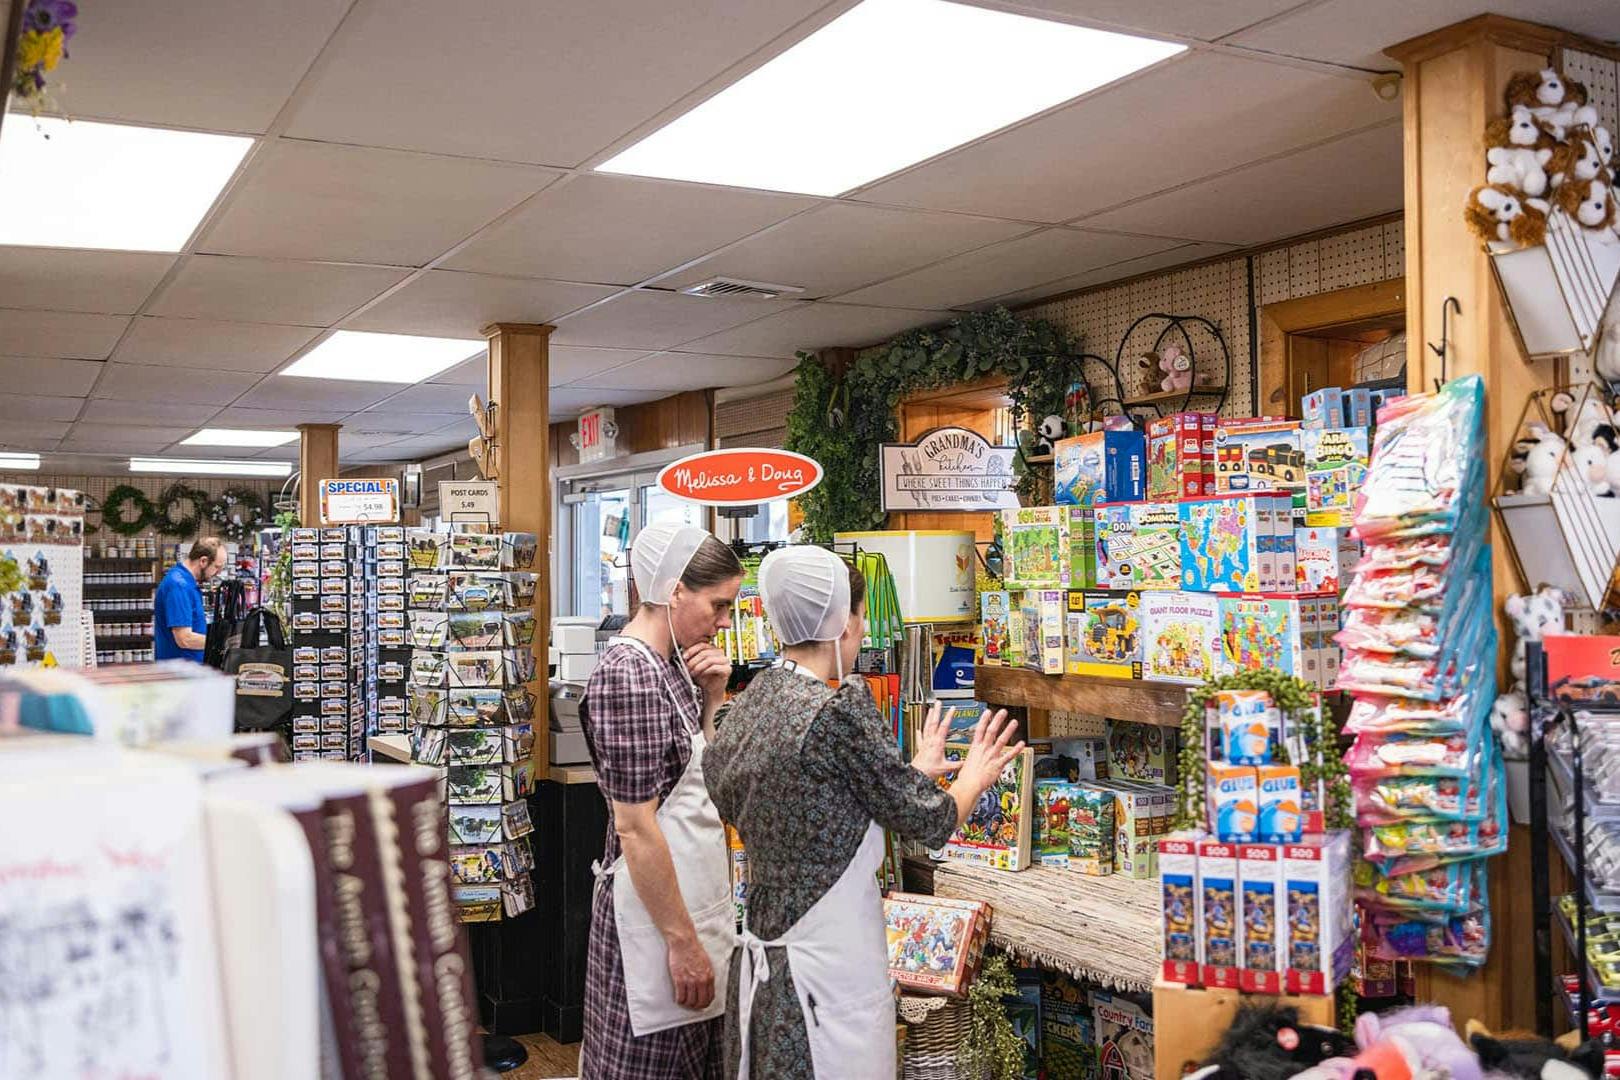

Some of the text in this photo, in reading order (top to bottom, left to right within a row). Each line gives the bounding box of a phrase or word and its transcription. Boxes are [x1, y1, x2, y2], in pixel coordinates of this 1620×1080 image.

[580, 413, 600, 449] EXIT
[1320, 431, 1348, 446] FARM
[923, 433, 985, 459] GRANDMA'S
[1315, 443, 1356, 457] BINGO
[674, 463, 803, 494] Melissa & Doug
[903, 479, 925, 489] WHERE
[929, 479, 952, 489] SWEET
[955, 479, 979, 489] THINGS
[328, 481, 391, 493] SPECIAL !
[450, 489, 489, 497] POST CARDS
[1149, 606, 1214, 618] GIANT FLOOR PUZZLE
[1231, 700, 1266, 716] GLUE
[1220, 775, 1255, 793] GLUE
[1262, 777, 1297, 793] GLUE
[1165, 842, 1188, 853] 500
[1206, 846, 1230, 857] 500
[1246, 848, 1270, 859] 500
[1290, 847, 1314, 859] 500
[1097, 1004, 1133, 1030] Country
